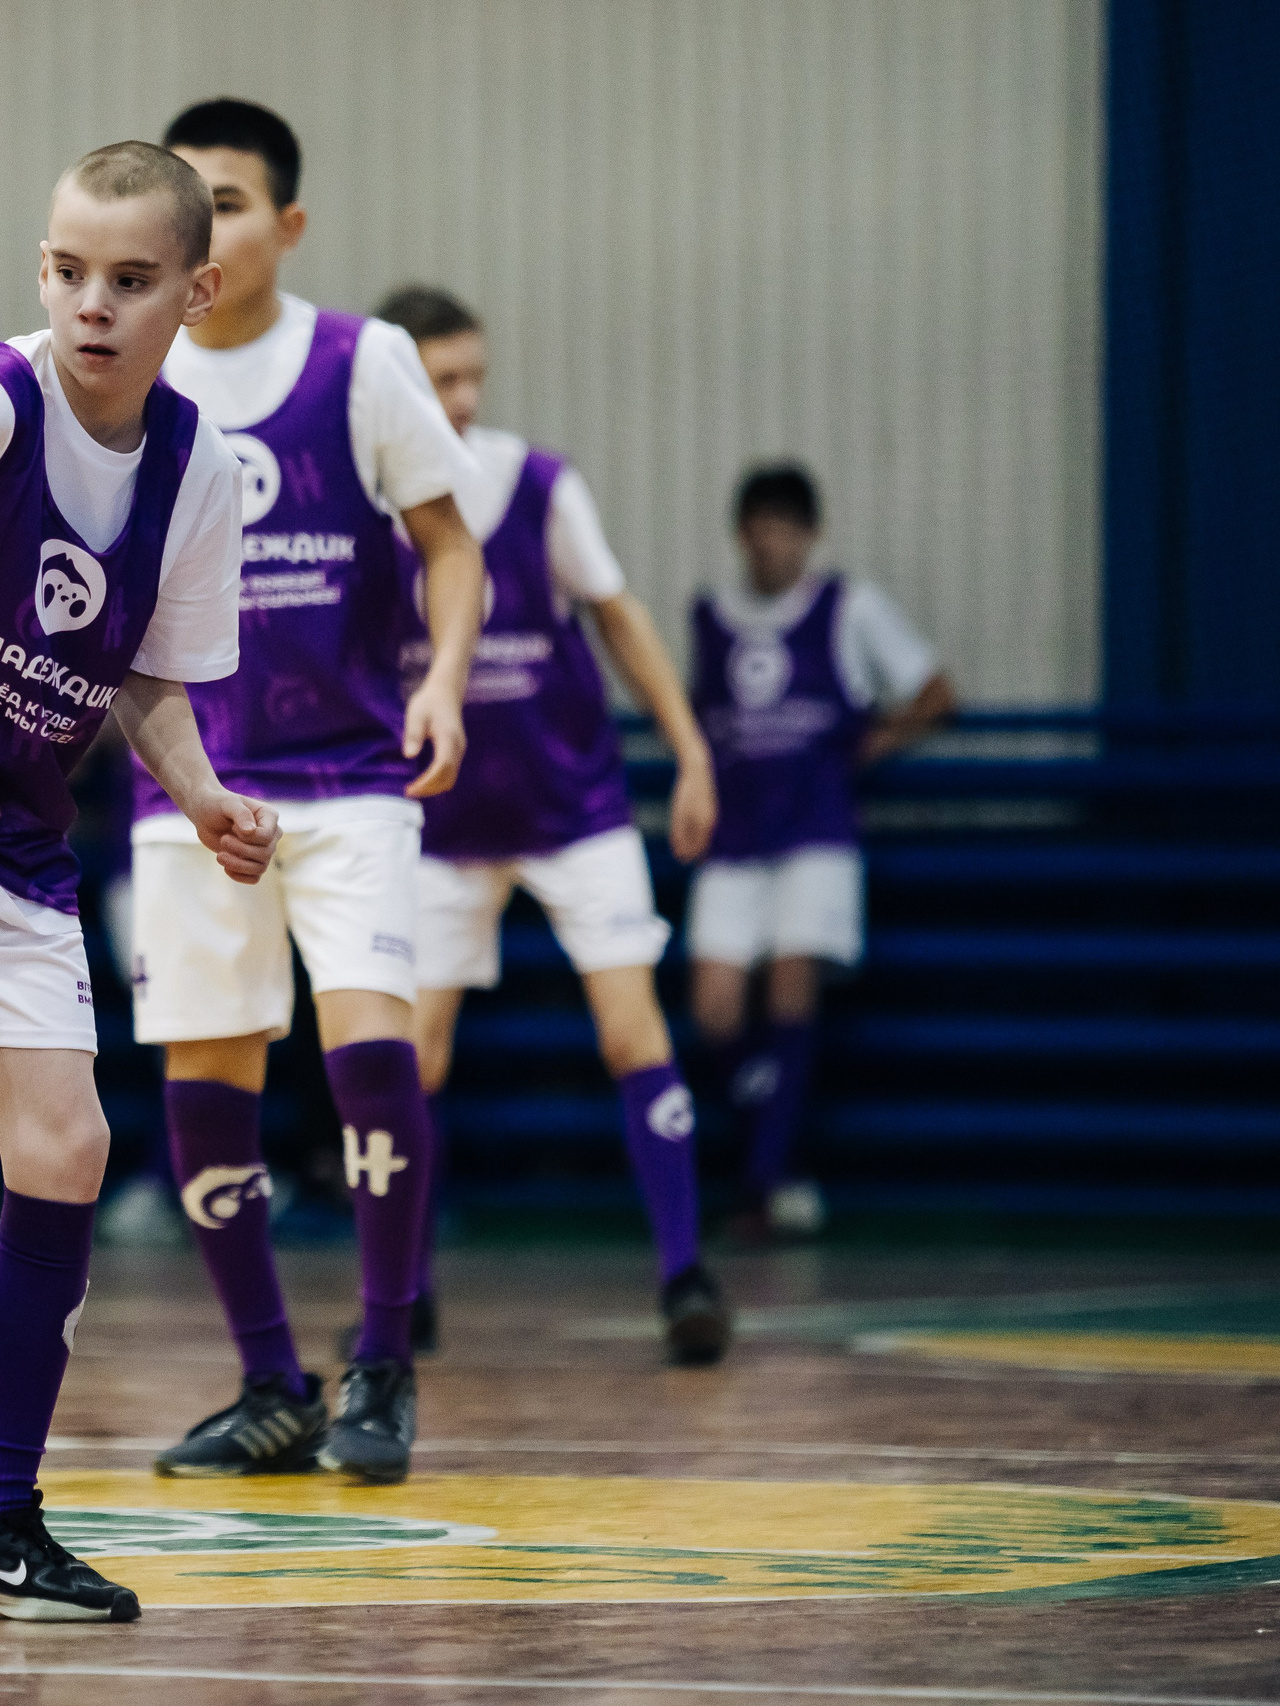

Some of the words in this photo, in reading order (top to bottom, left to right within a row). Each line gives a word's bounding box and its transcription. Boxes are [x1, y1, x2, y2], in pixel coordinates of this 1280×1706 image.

[241, 532, 357, 564] ЕЖДИК
[4, 707, 38, 734] МЫ
[25, 701, 40, 717] К
